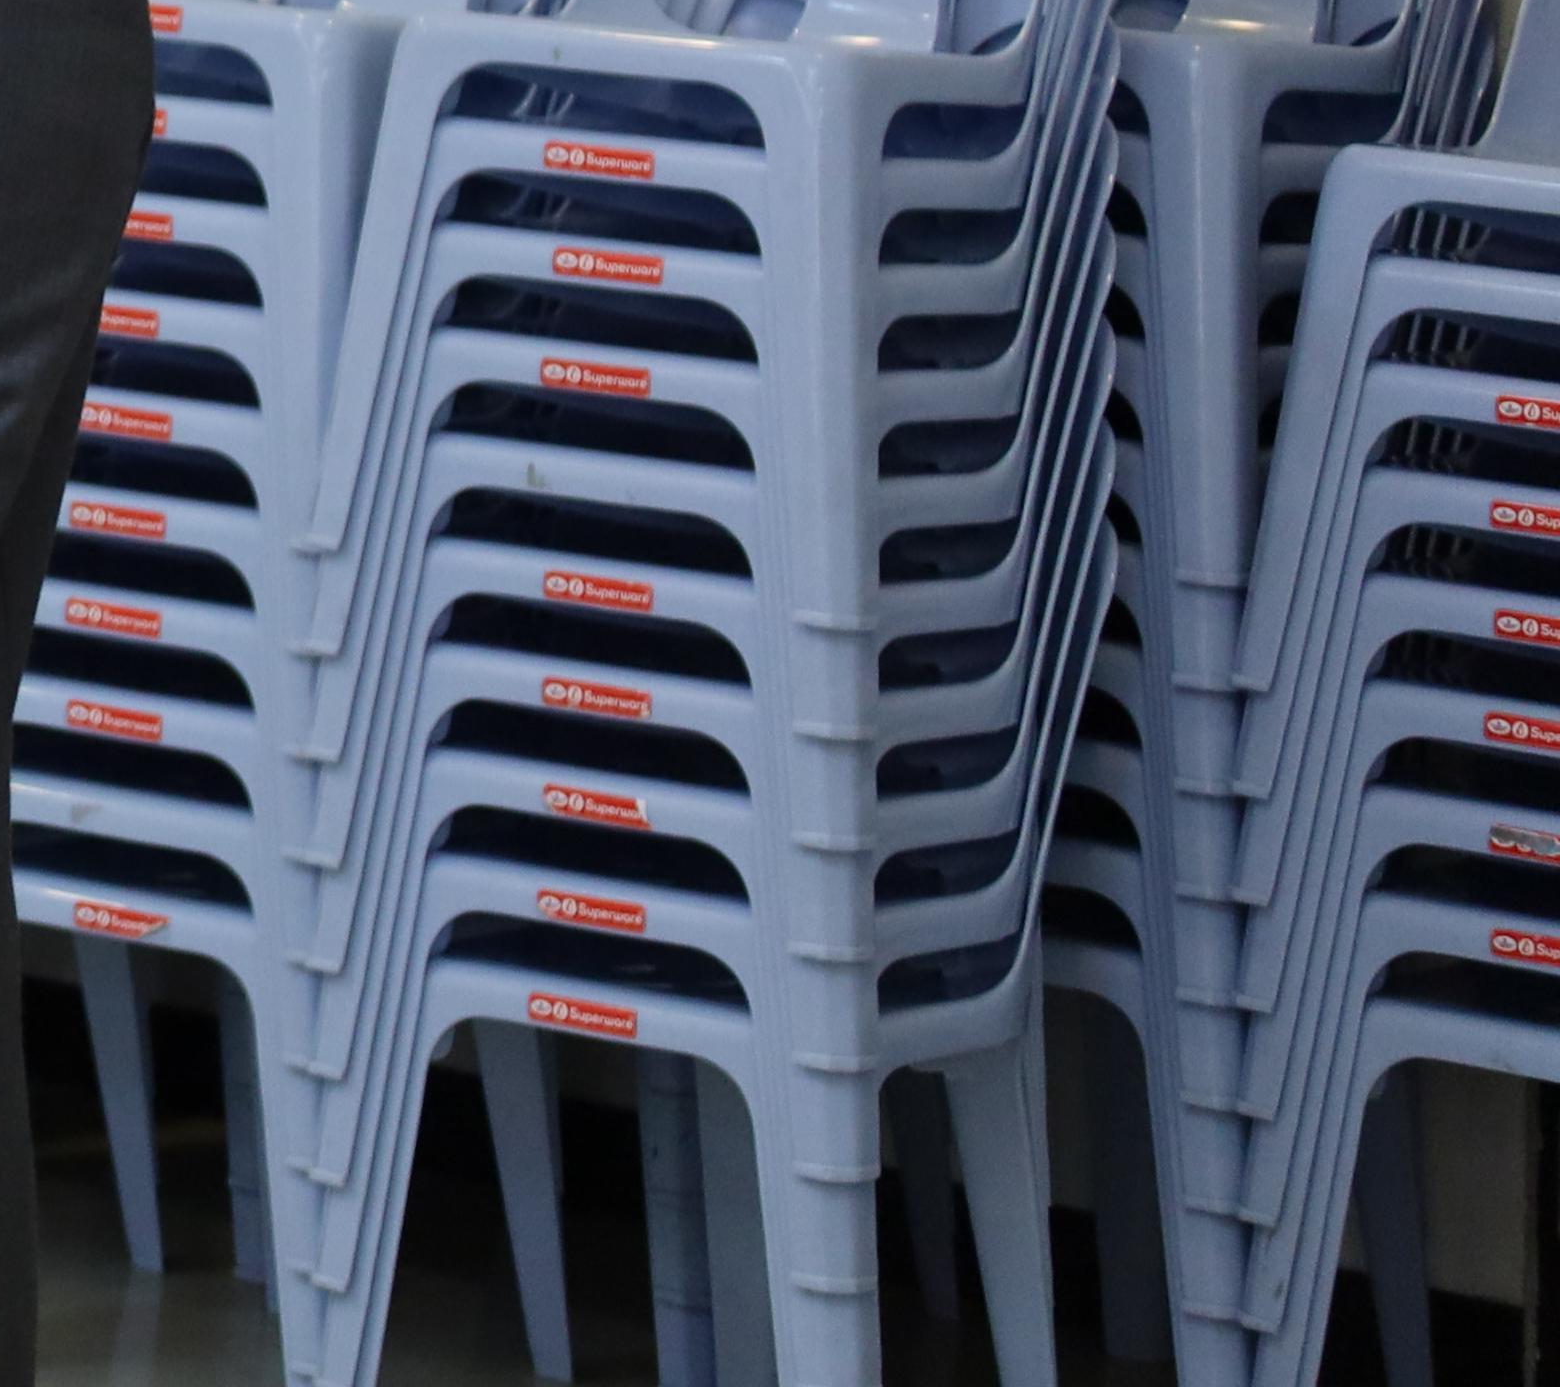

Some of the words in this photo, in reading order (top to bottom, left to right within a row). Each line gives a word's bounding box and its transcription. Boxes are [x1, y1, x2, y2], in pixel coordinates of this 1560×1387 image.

[586, 150, 651, 172] Superware
[595, 256, 660, 277] Superware
[582, 368, 647, 390] Superware
[585, 582, 649, 604] Superware
[585, 797, 645, 819] Superwa
[579, 901, 643, 925] Superware
[570, 1005, 633, 1029] Superware
